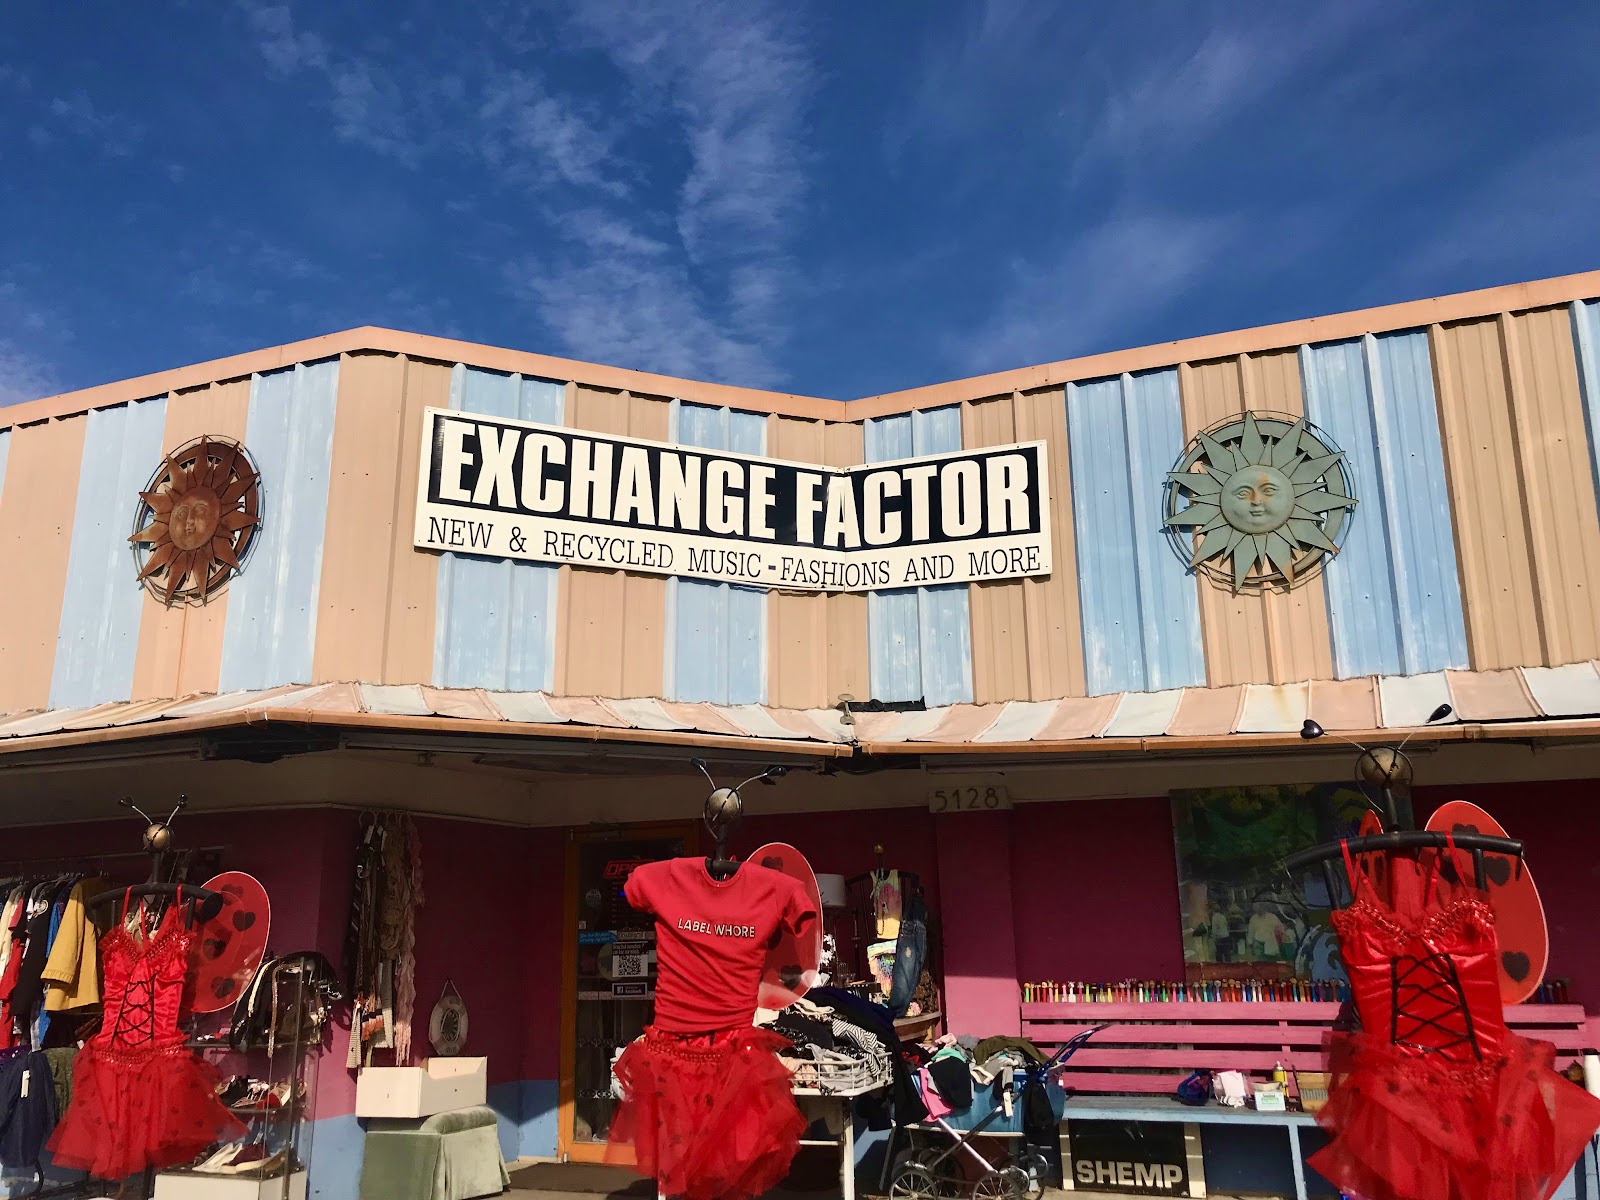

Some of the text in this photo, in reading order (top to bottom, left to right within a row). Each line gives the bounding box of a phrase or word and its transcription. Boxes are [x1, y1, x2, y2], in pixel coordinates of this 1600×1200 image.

[439, 419, 1031, 548] EXCHANGE FACTOR
[427, 516, 494, 549] NEW
[509, 526, 527, 553] &
[543, 530, 674, 569] RECYCLED
[903, 555, 955, 583] AND
[968, 546, 1040, 577] MORE
[934, 787, 999, 811] 5128
[678, 918, 755, 938] LABEL WHORE
[1075, 1159, 1183, 1189] SHEMP
